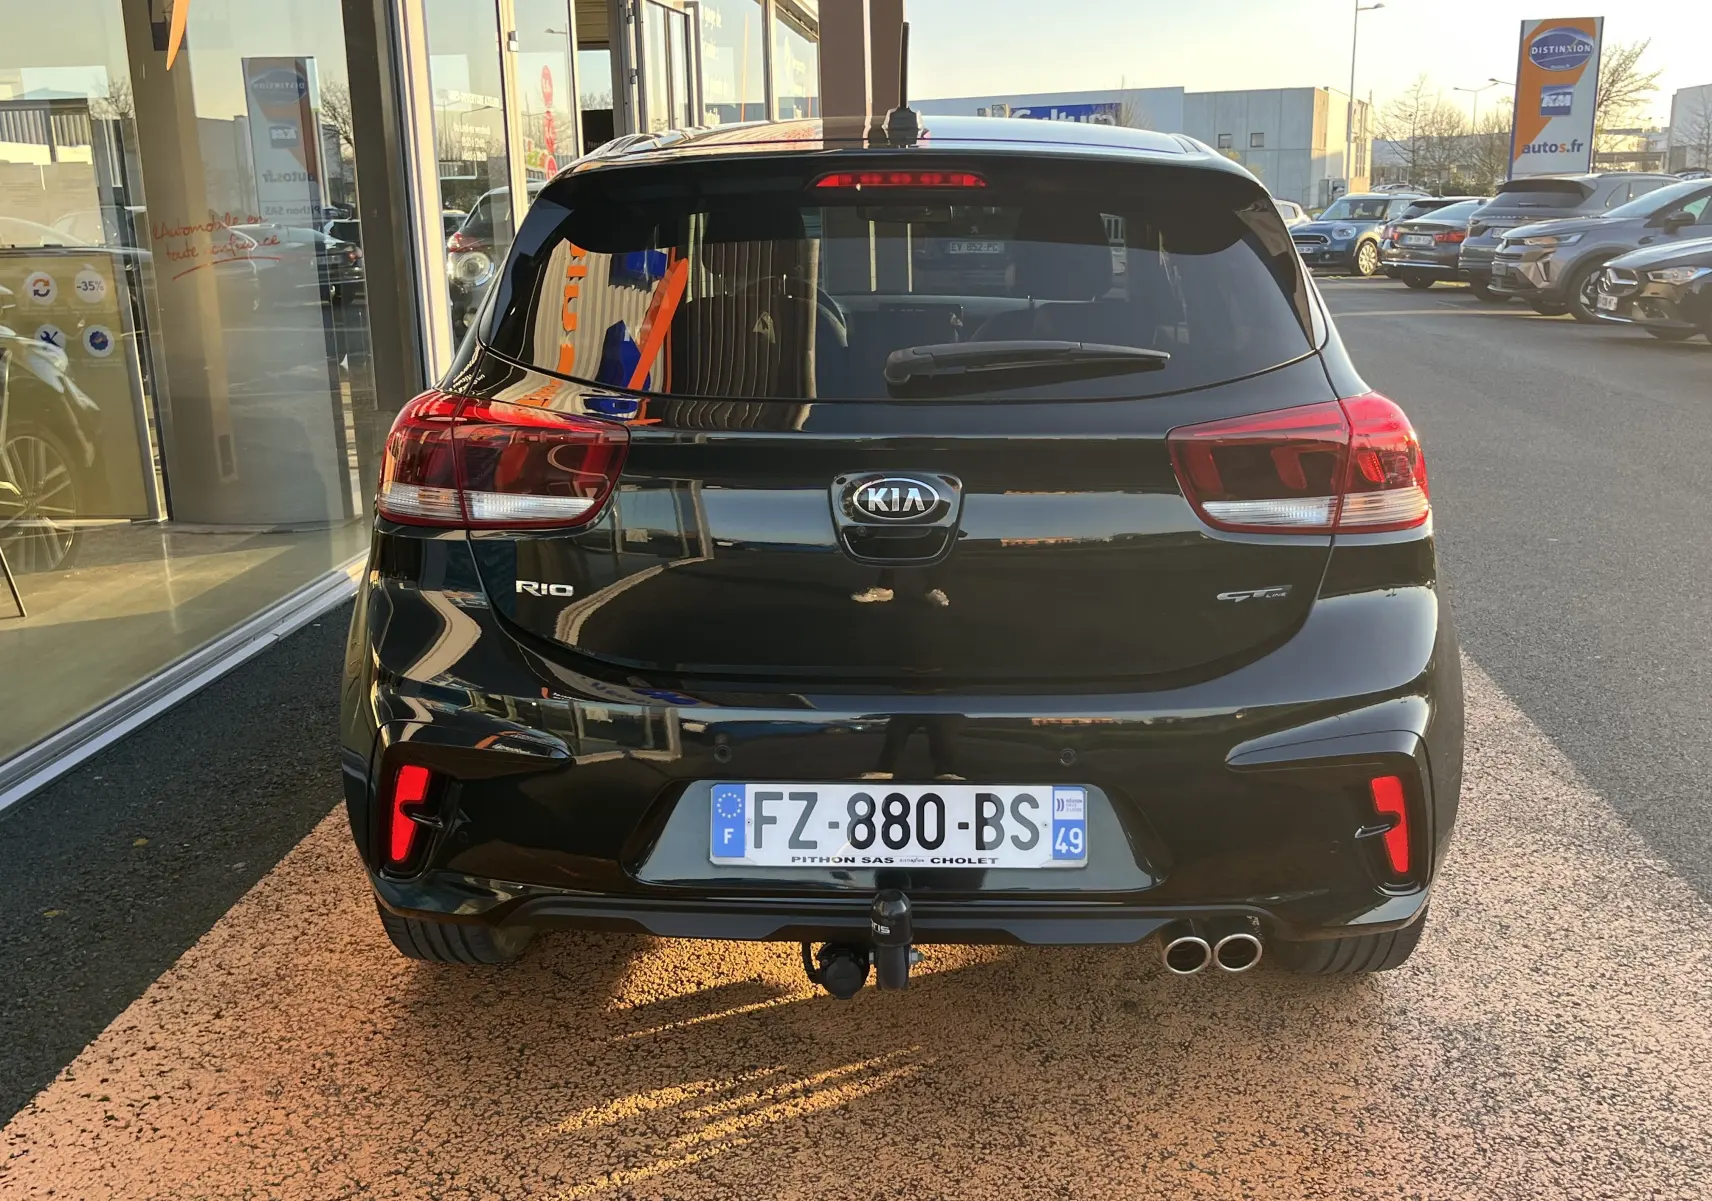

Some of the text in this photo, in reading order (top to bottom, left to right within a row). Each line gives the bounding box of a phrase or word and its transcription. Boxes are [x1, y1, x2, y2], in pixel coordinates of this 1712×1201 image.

[1531, 42, 1592, 55] DISTINXION
[1522, 138, 1584, 154] autos.fr
[76, 281, 105, 292] -35%
[867, 487, 926, 512] KIA
[515, 580, 574, 597] RIO
[754, 791, 1040, 851] FZ-880-BS
[723, 828, 734, 845] F
[1054, 827, 1083, 854] 49
[791, 856, 856, 864] PITHON
